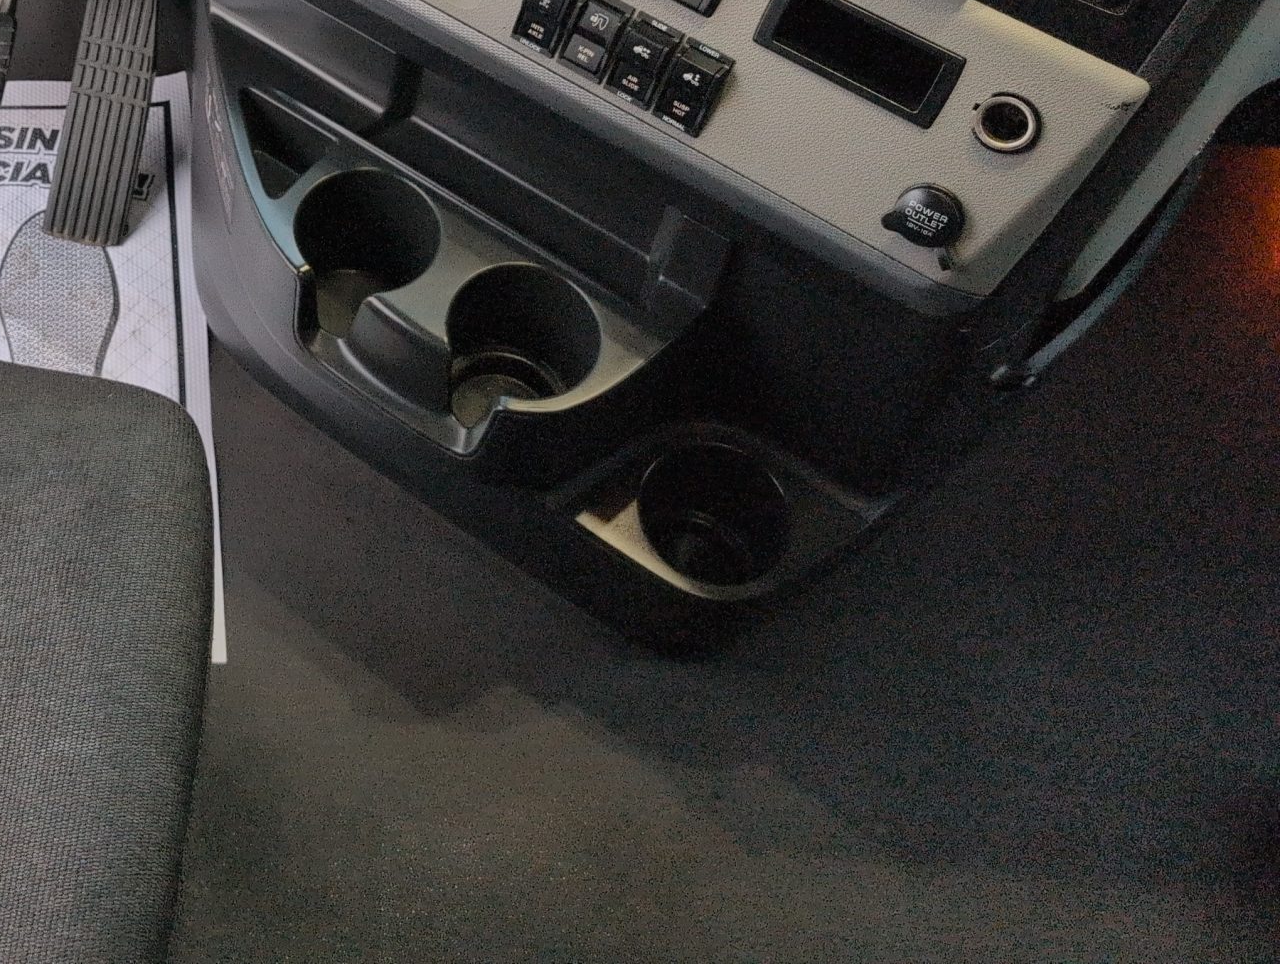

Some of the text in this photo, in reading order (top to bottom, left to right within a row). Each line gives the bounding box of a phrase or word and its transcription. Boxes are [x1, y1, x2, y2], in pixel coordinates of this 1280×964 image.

[651, 19, 668, 32] SLIDE
[527, 29, 543, 40] AXLE
[519, 37, 541, 53] UNLOCK
[699, 44, 720, 59] LOWER
[576, 52, 589, 63] REL
[621, 78, 640, 92] SLIDE
[627, 74, 638, 83] AIR
[617, 90, 632, 102] LOCK
[673, 100, 691, 112] SUSP
[661, 115, 685, 132] NORMAL
[905, 207, 945, 230] OUTLET
[909, 200, 948, 224] POWER
